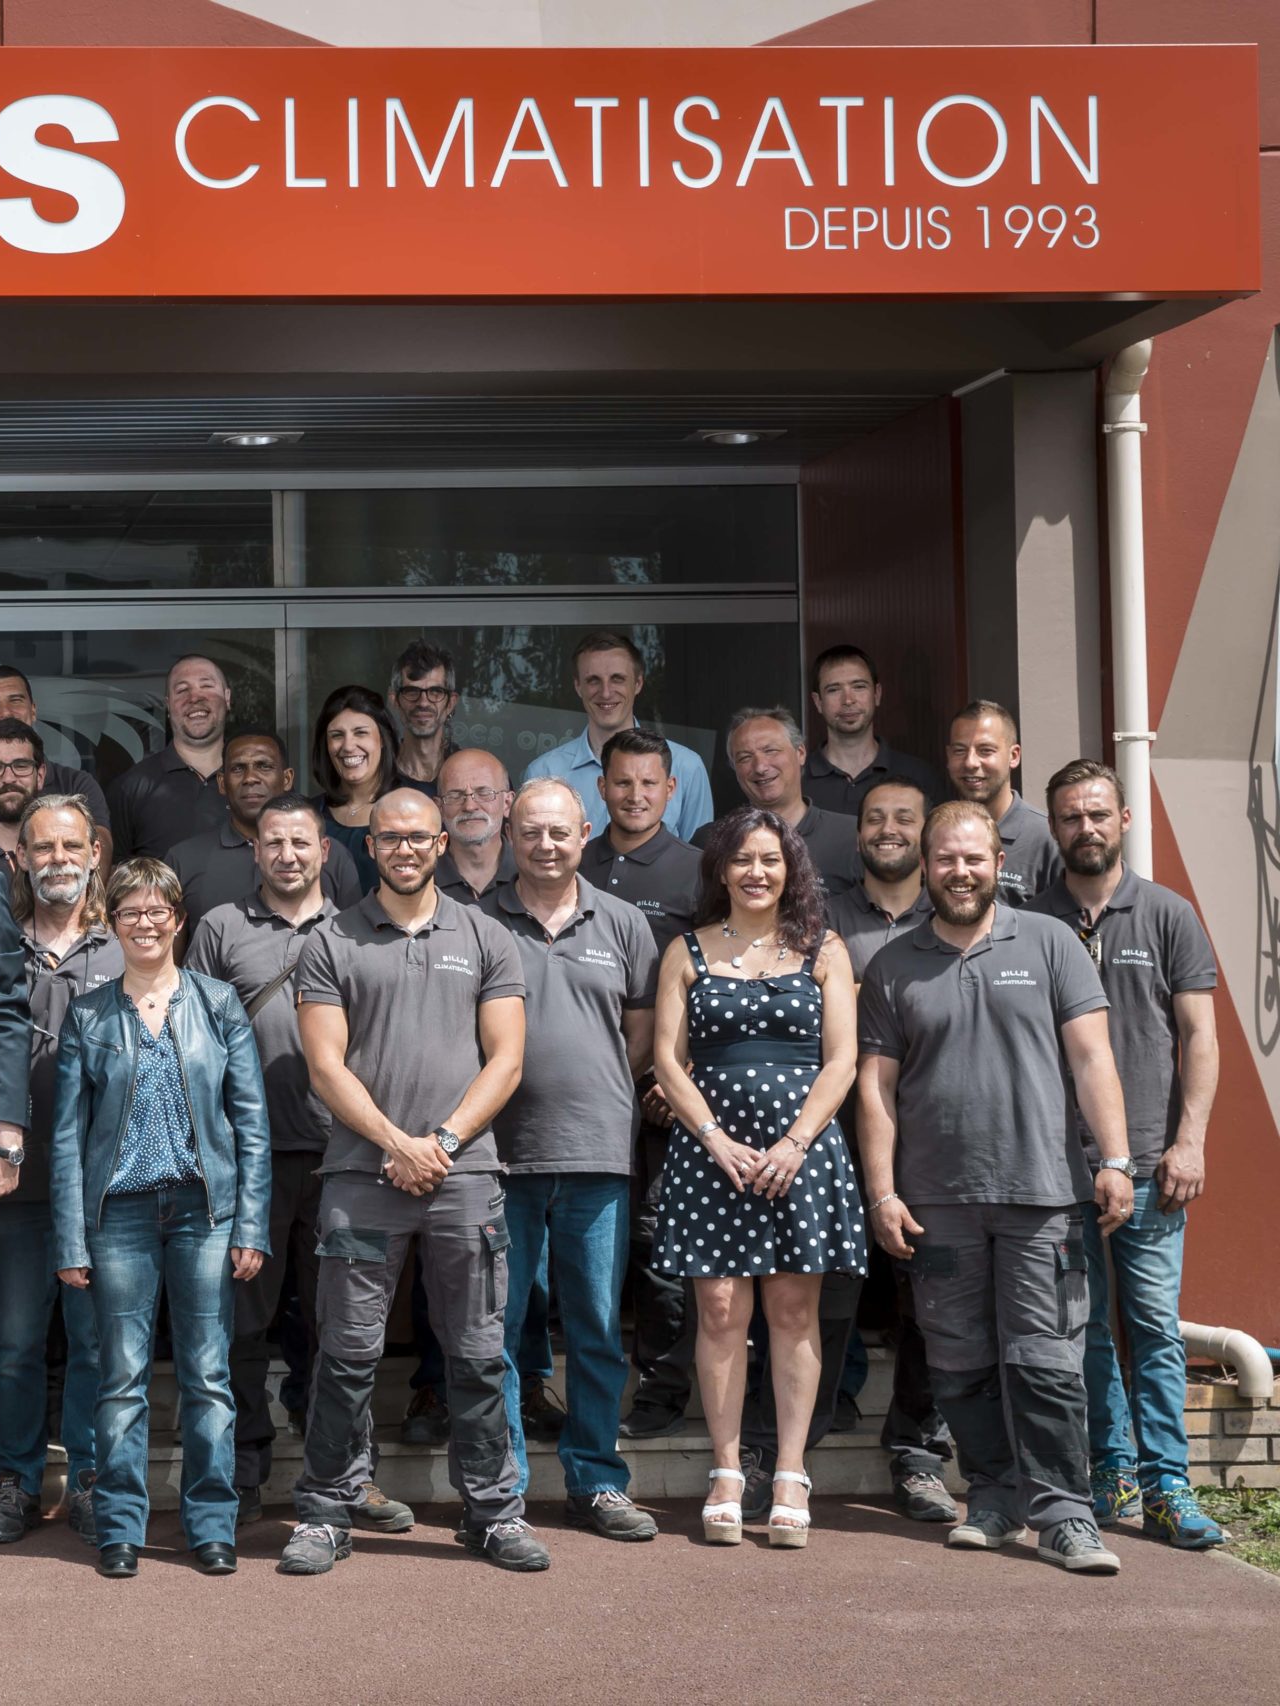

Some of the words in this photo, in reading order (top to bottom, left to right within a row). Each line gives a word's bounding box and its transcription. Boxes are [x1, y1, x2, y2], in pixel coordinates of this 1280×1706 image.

[175, 95, 1098, 189] CLIMATISATION
[785, 206, 951, 250] DEPUIS
[977, 205, 1099, 248] 1993
[997, 871, 1023, 881] BILLIS
[636, 900, 661, 909] BILLIS
[585, 949, 611, 959] BILLIS
[1121, 949, 1149, 958] BILLIS
[442, 955, 469, 966] BILLIS
[1000, 969, 1029, 978] BILLIS
